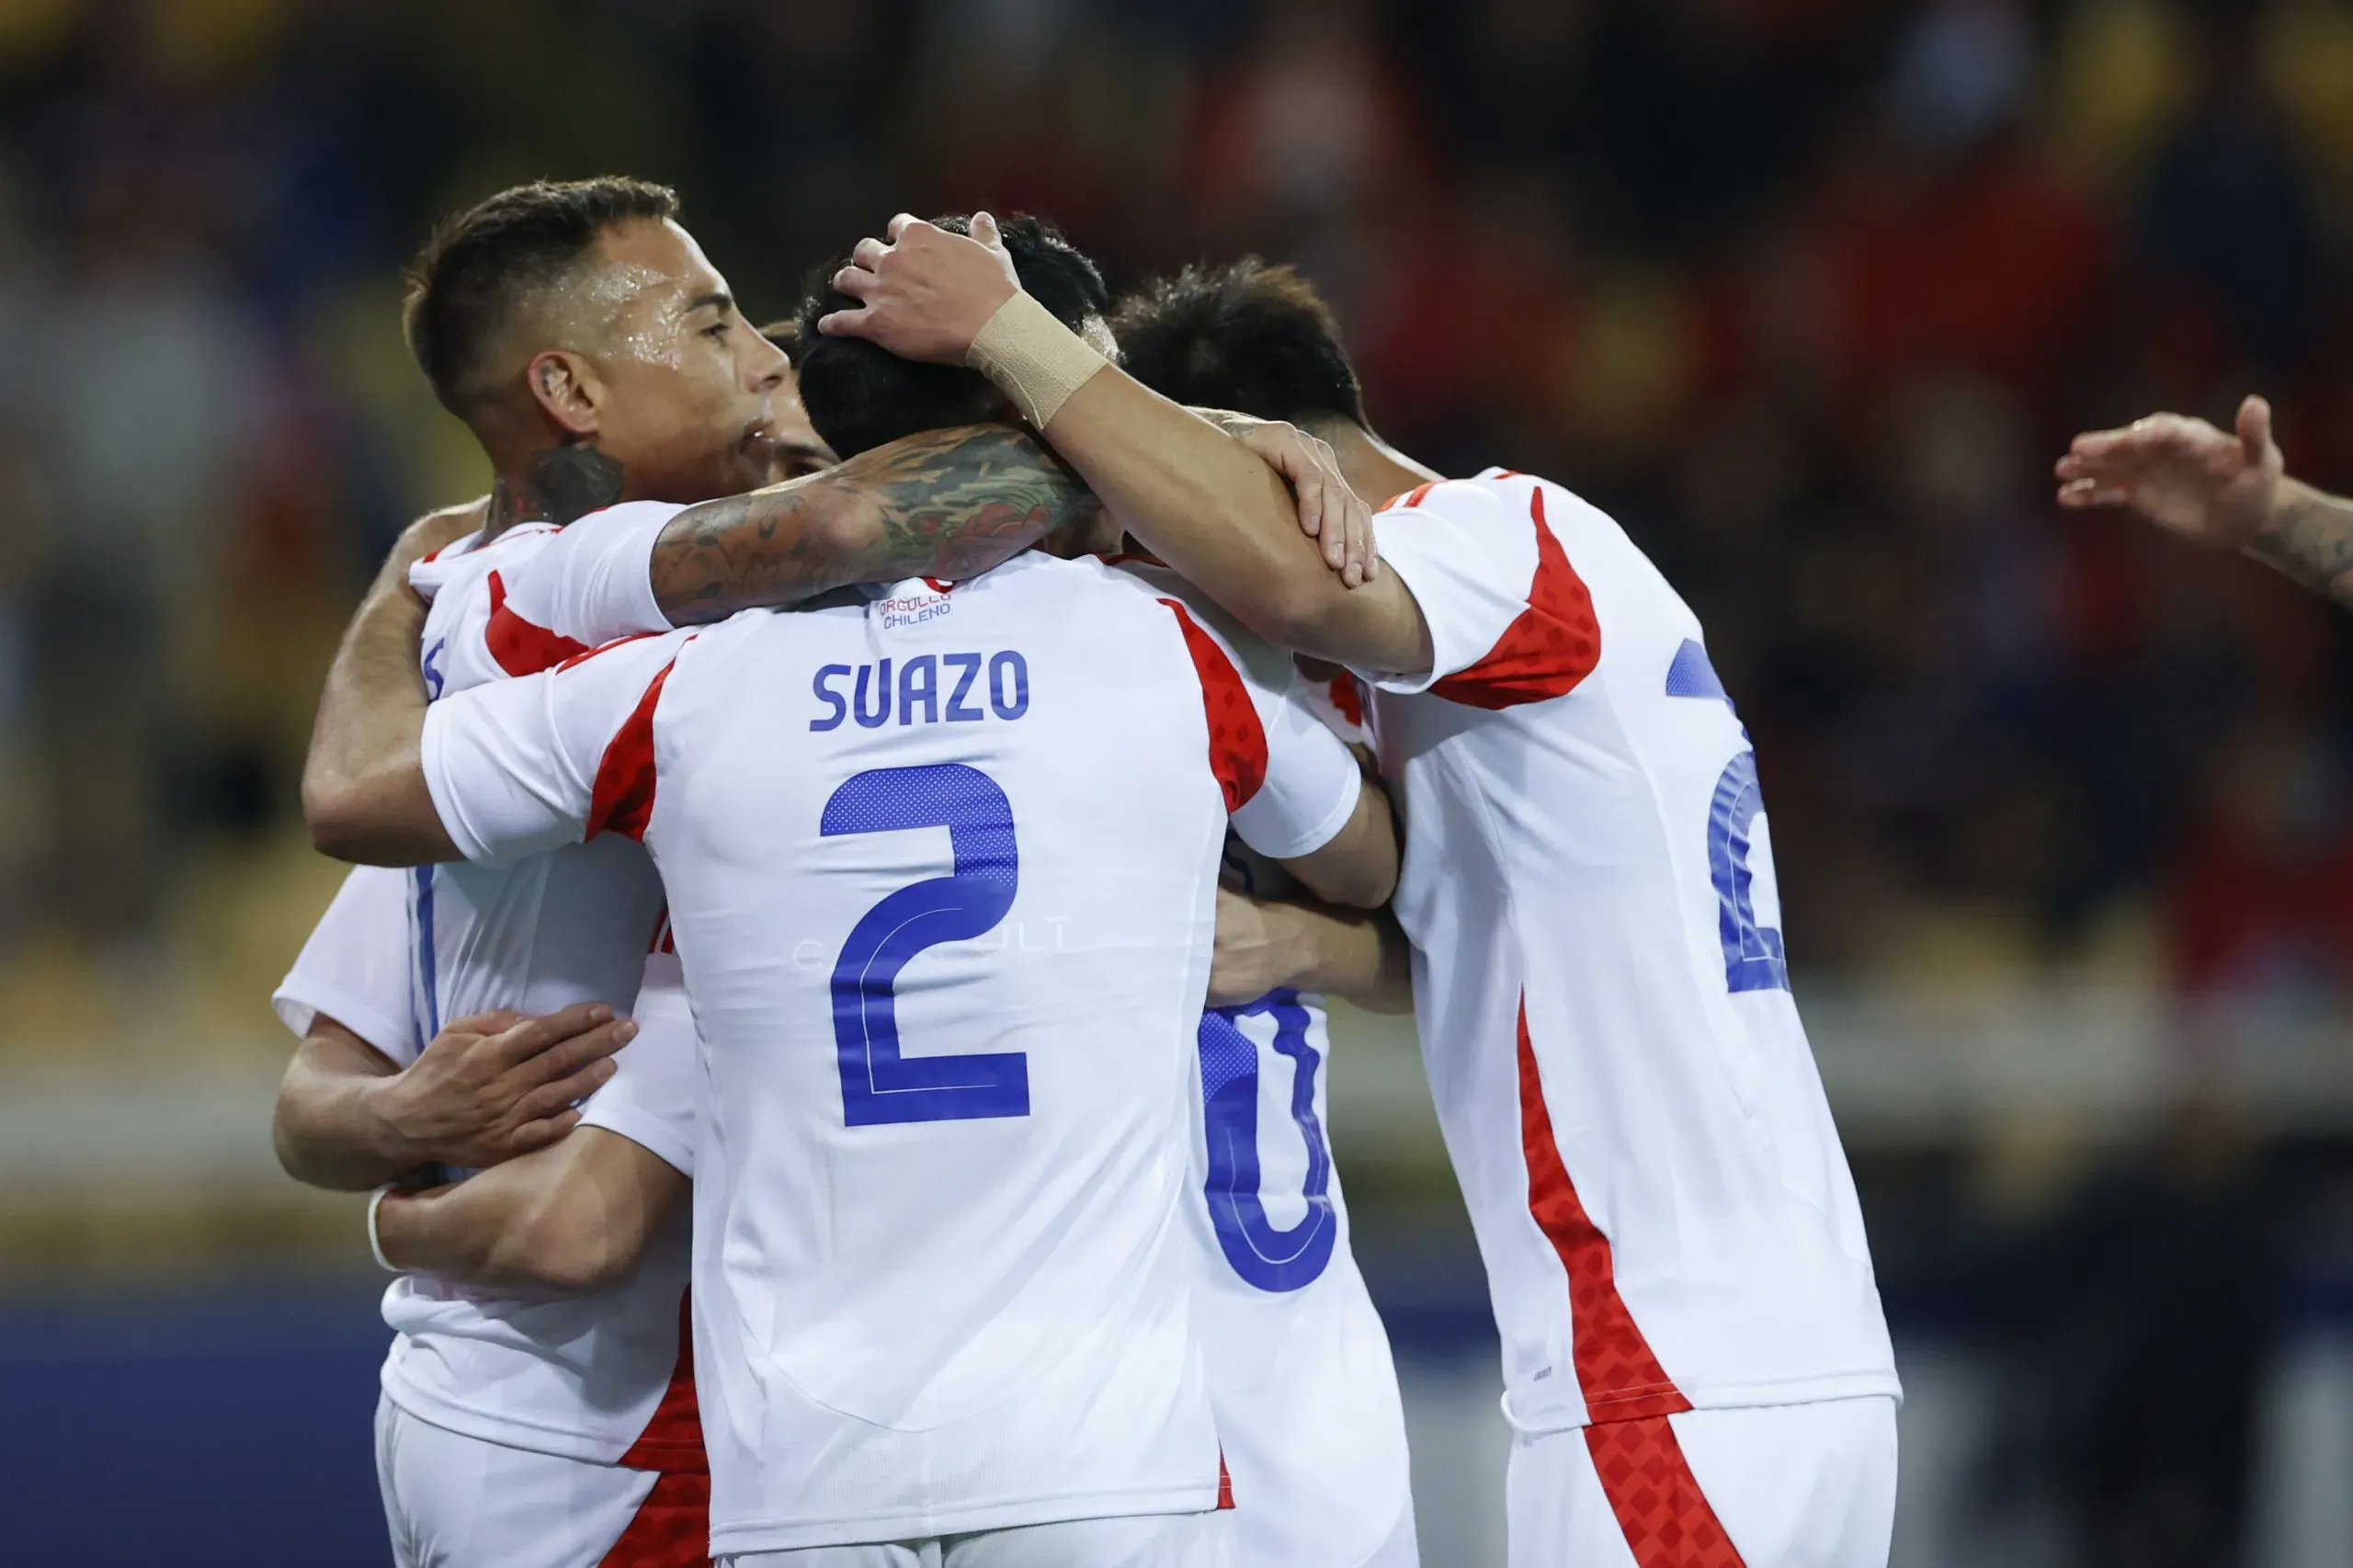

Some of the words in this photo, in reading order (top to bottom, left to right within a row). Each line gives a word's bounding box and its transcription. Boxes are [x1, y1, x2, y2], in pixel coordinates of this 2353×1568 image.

[884, 603, 951, 630] CHILENO
[809, 650, 1029, 733] SUAZO
[820, 763, 1030, 1128] 2
